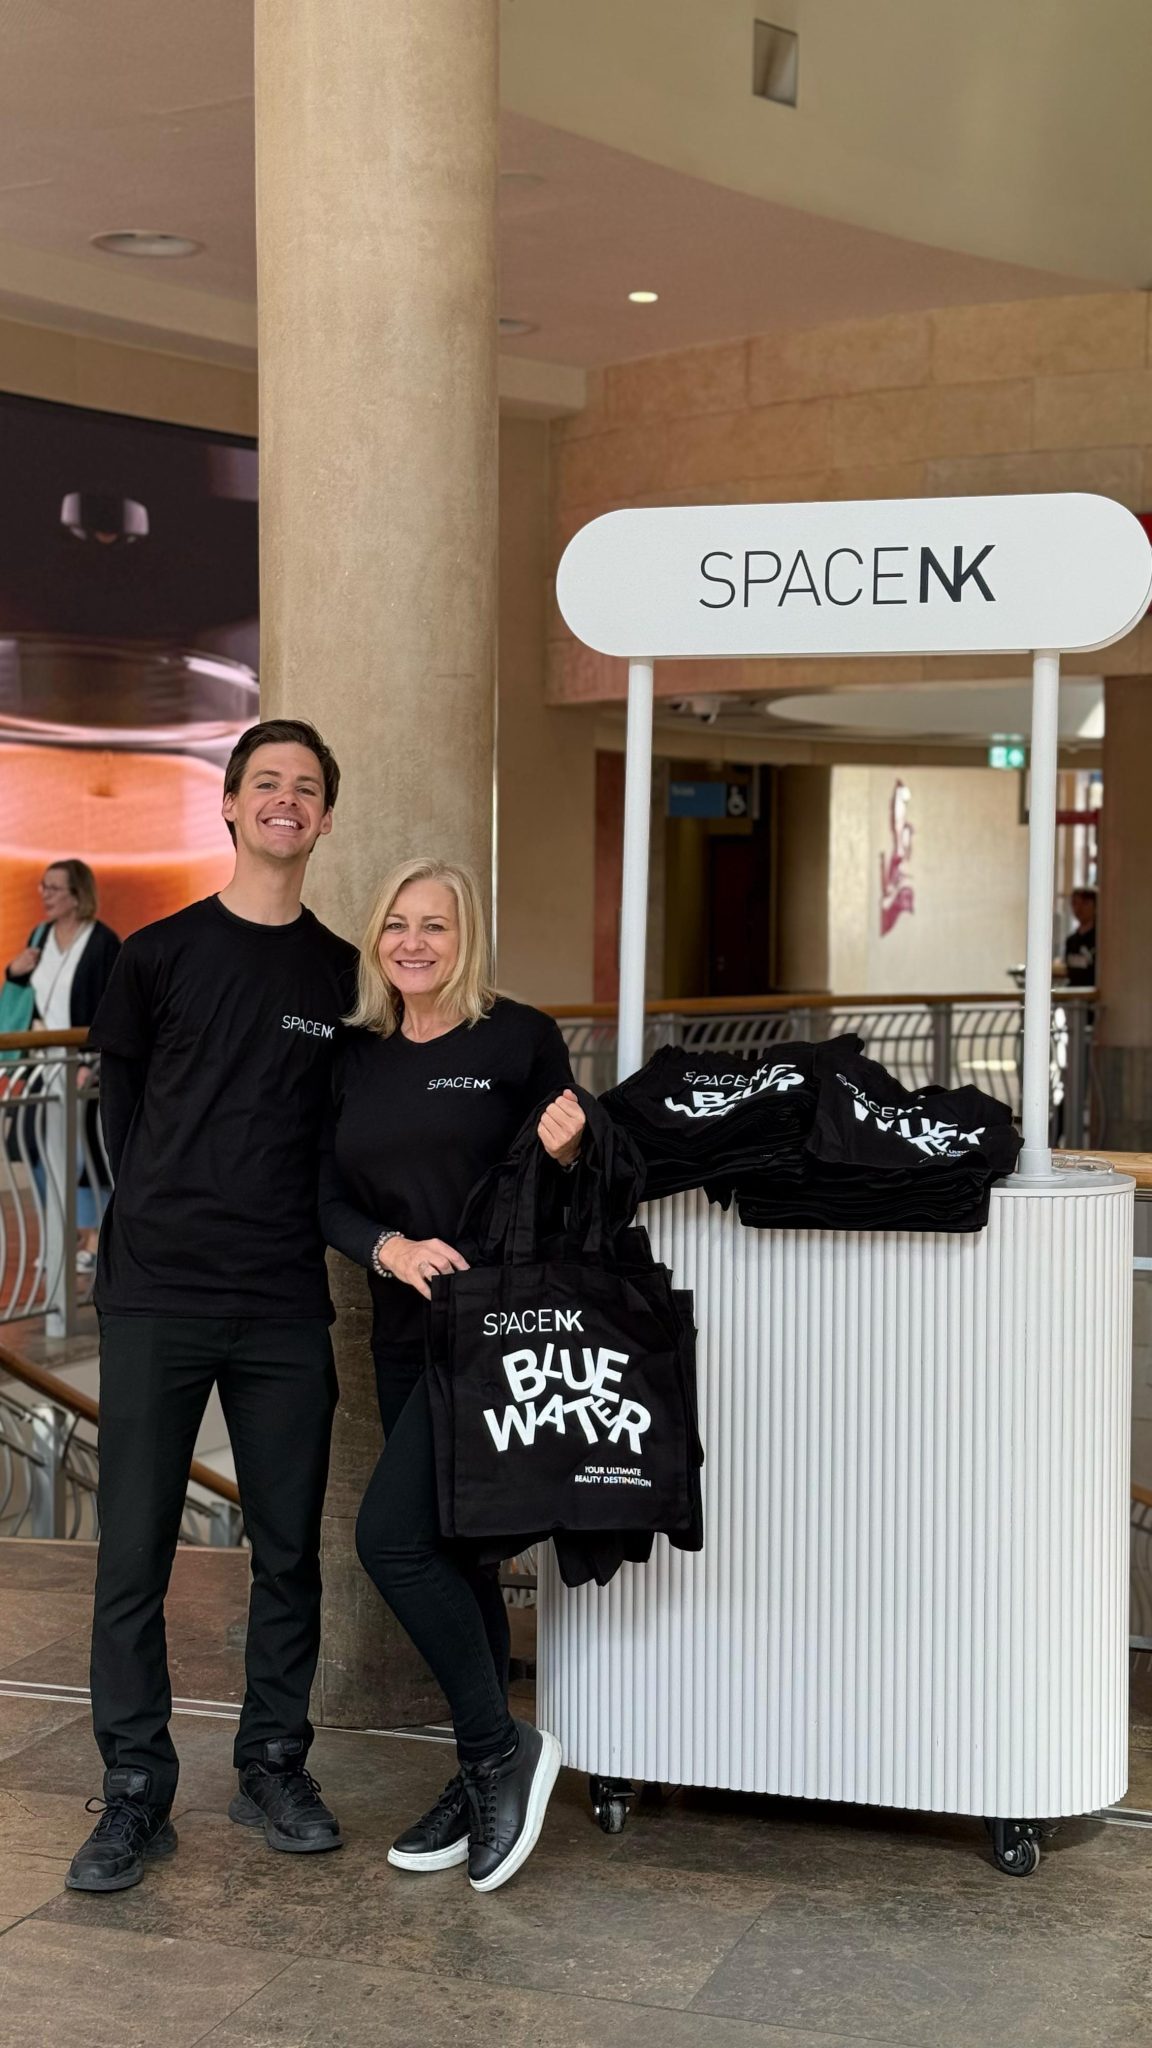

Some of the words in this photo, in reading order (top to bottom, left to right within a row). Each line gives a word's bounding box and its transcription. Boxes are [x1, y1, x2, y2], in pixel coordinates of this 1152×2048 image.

[699, 544, 997, 609] SPACENK
[281, 1015, 336, 1040] SPACENK
[426, 1076, 492, 1091] SPACENK
[482, 1308, 585, 1336] SPACENK
[502, 1342, 630, 1404] BLUE
[482, 1393, 652, 1456] WATER
[574, 1474, 602, 1484] BEAUTY
[603, 1475, 652, 1488] DESTINATION
[584, 1465, 605, 1475] YOUR
[606, 1466, 642, 1477] ULTIMATE
